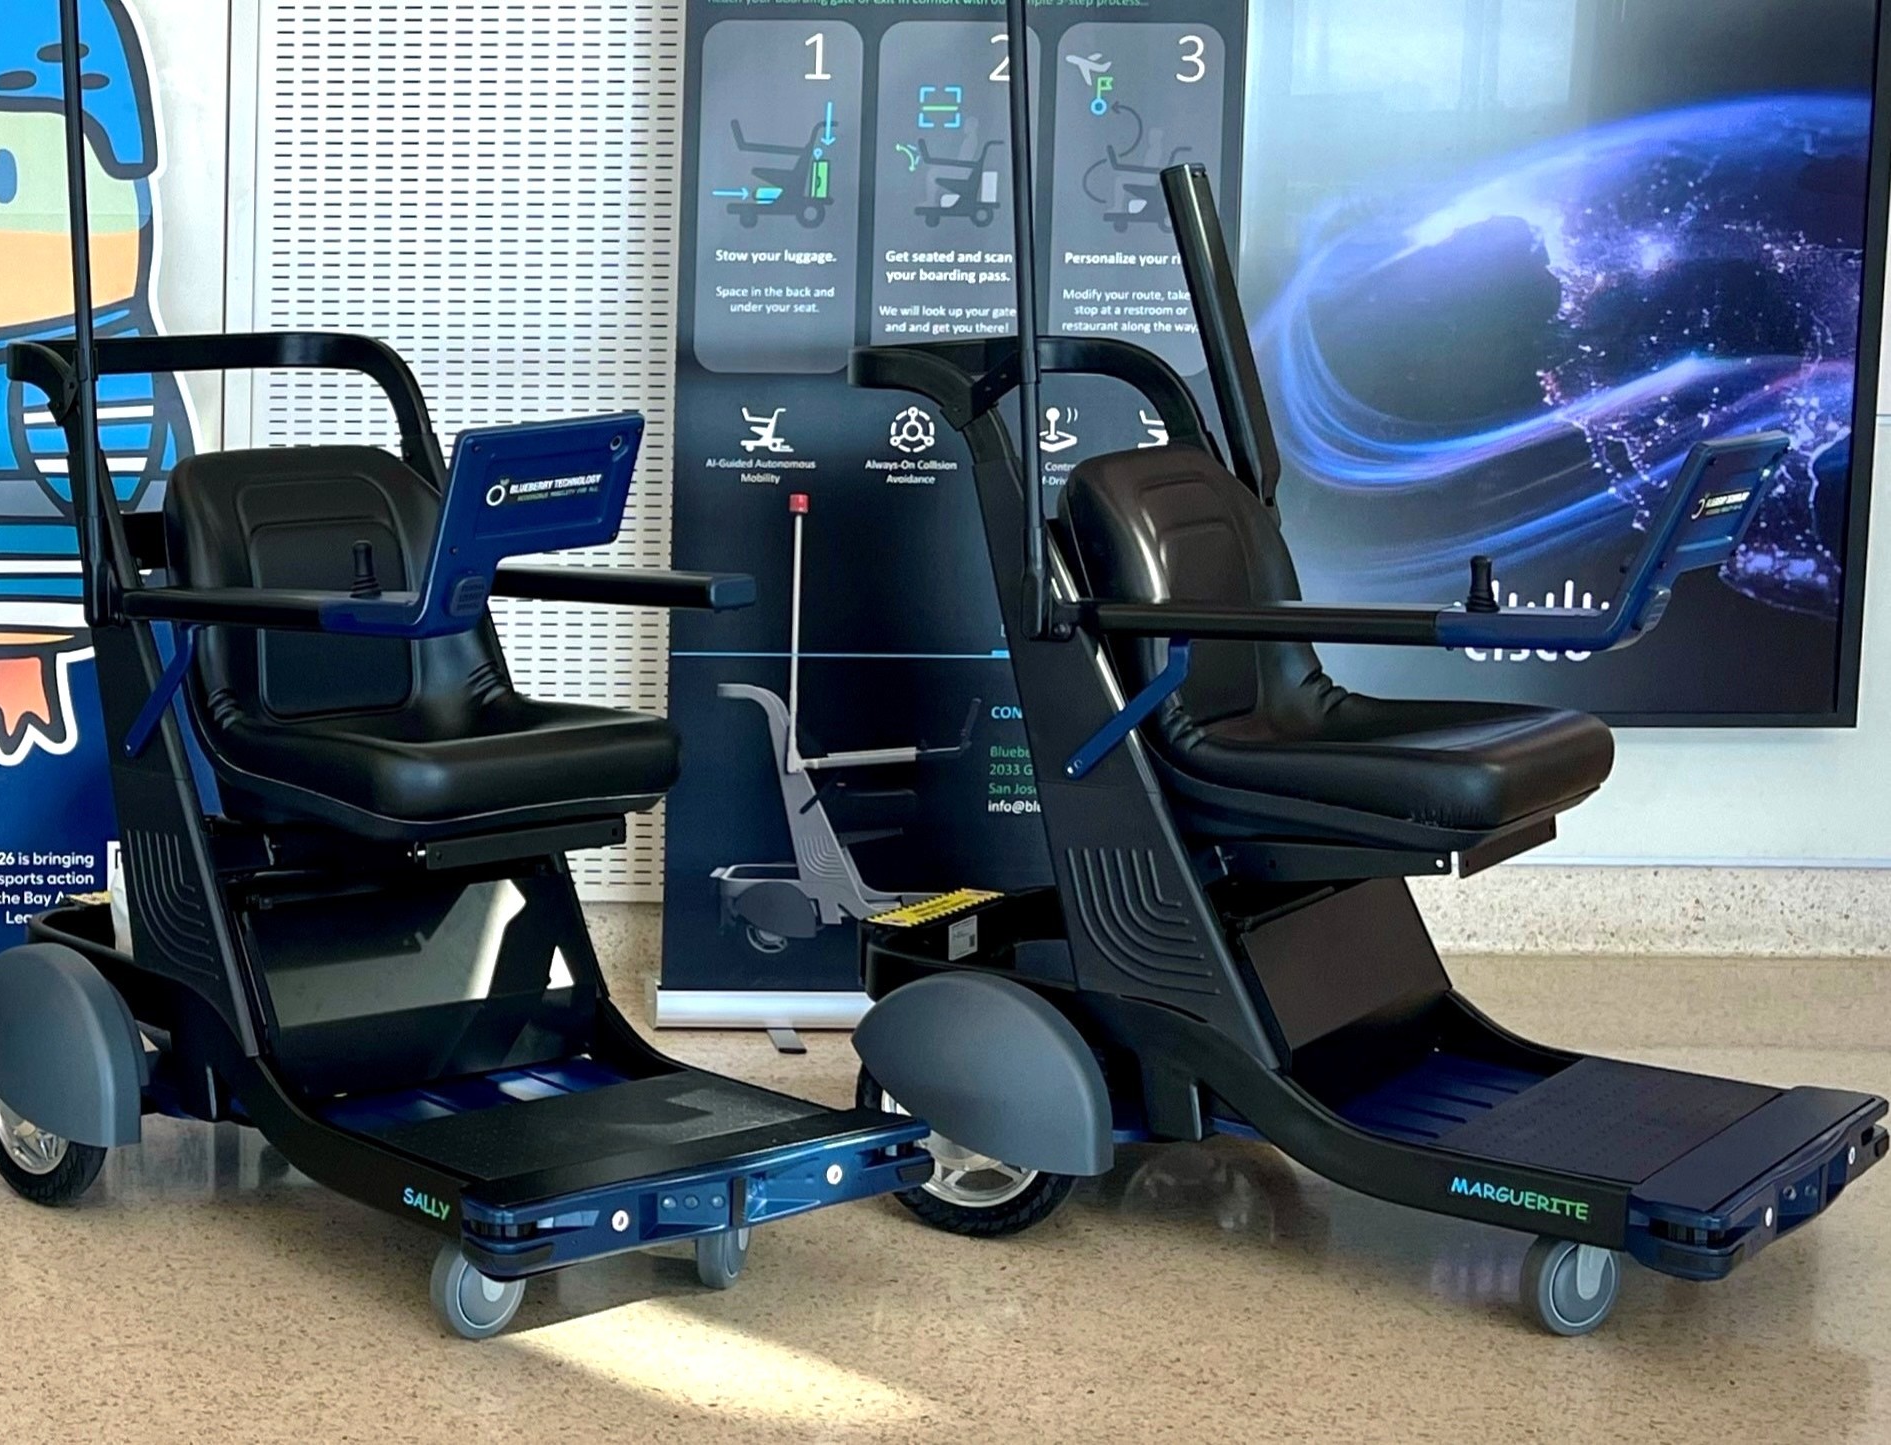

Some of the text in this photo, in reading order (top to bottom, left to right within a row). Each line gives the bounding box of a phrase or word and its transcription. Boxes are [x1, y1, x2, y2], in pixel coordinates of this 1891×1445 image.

[805, 33, 831, 80] 1
[989, 34, 1010, 81] 2
[1176, 35, 1205, 82] 3
[715, 249, 837, 264] Stow your luggage.
[885, 250, 1013, 263] Get seated and scan
[1065, 252, 1136, 265] Personalize
[1139, 254, 1168, 267] your
[886, 269, 1011, 284] your boarding pass.
[715, 286, 835, 299] Space in the back and
[1063, 289, 1191, 302] Modify your route, take
[730, 301, 820, 314] under your seat.
[879, 305, 1017, 319] We will look up your gate
[1074, 306, 1188, 317] stop at a restroom or
[885, 322, 1009, 335] and and get you there!
[1062, 322, 1118, 332] restaurant
[1121, 321, 1151, 334] along
[1153, 321, 1172, 333] the
[706, 459, 816, 469] AI-Guided Autonomous
[865, 460, 958, 471] Always-On Collision
[1044, 462, 1076, 472] Contr
[510, 474, 602, 494] BLUEBERRY TECHNOLOGY
[740, 473, 780, 484] Mobility
[886, 474, 936, 484] Avoidance
[989, 763, 1021, 776] 2033
[989, 783, 1037, 795] San Jos
[18, 852, 30, 866] is
[33, 852, 94, 868] bringing
[47, 872, 95, 886] action
[24, 892, 51, 907] Bay
[403, 1187, 451, 1220] SALLY
[1451, 1177, 1589, 1221] MARGUERITE
